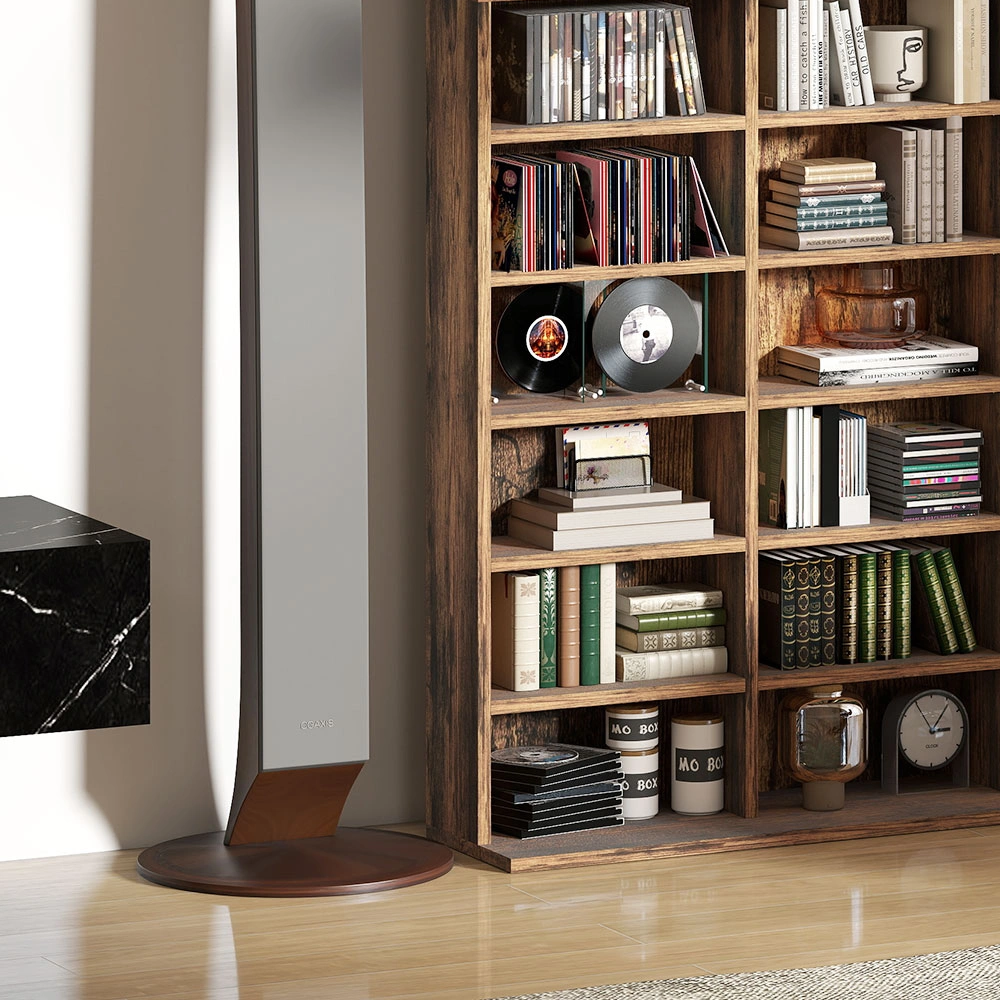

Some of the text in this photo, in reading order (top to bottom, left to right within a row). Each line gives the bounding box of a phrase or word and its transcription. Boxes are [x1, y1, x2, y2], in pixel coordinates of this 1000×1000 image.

[800, 5, 808, 26] fish
[800, 42, 808, 68] catch
[855, 25, 870, 75] OLD CARS
[845, 29, 860, 88] CAR HISTORY
[801, 74, 808, 84] to
[860, 370, 930, 380] MOCKINGBIRD
[962, 366, 977, 374] TO
[611, 722, 659, 735] MO BOX
[679, 757, 700, 772] MO
[638, 778, 658, 791] BOX
